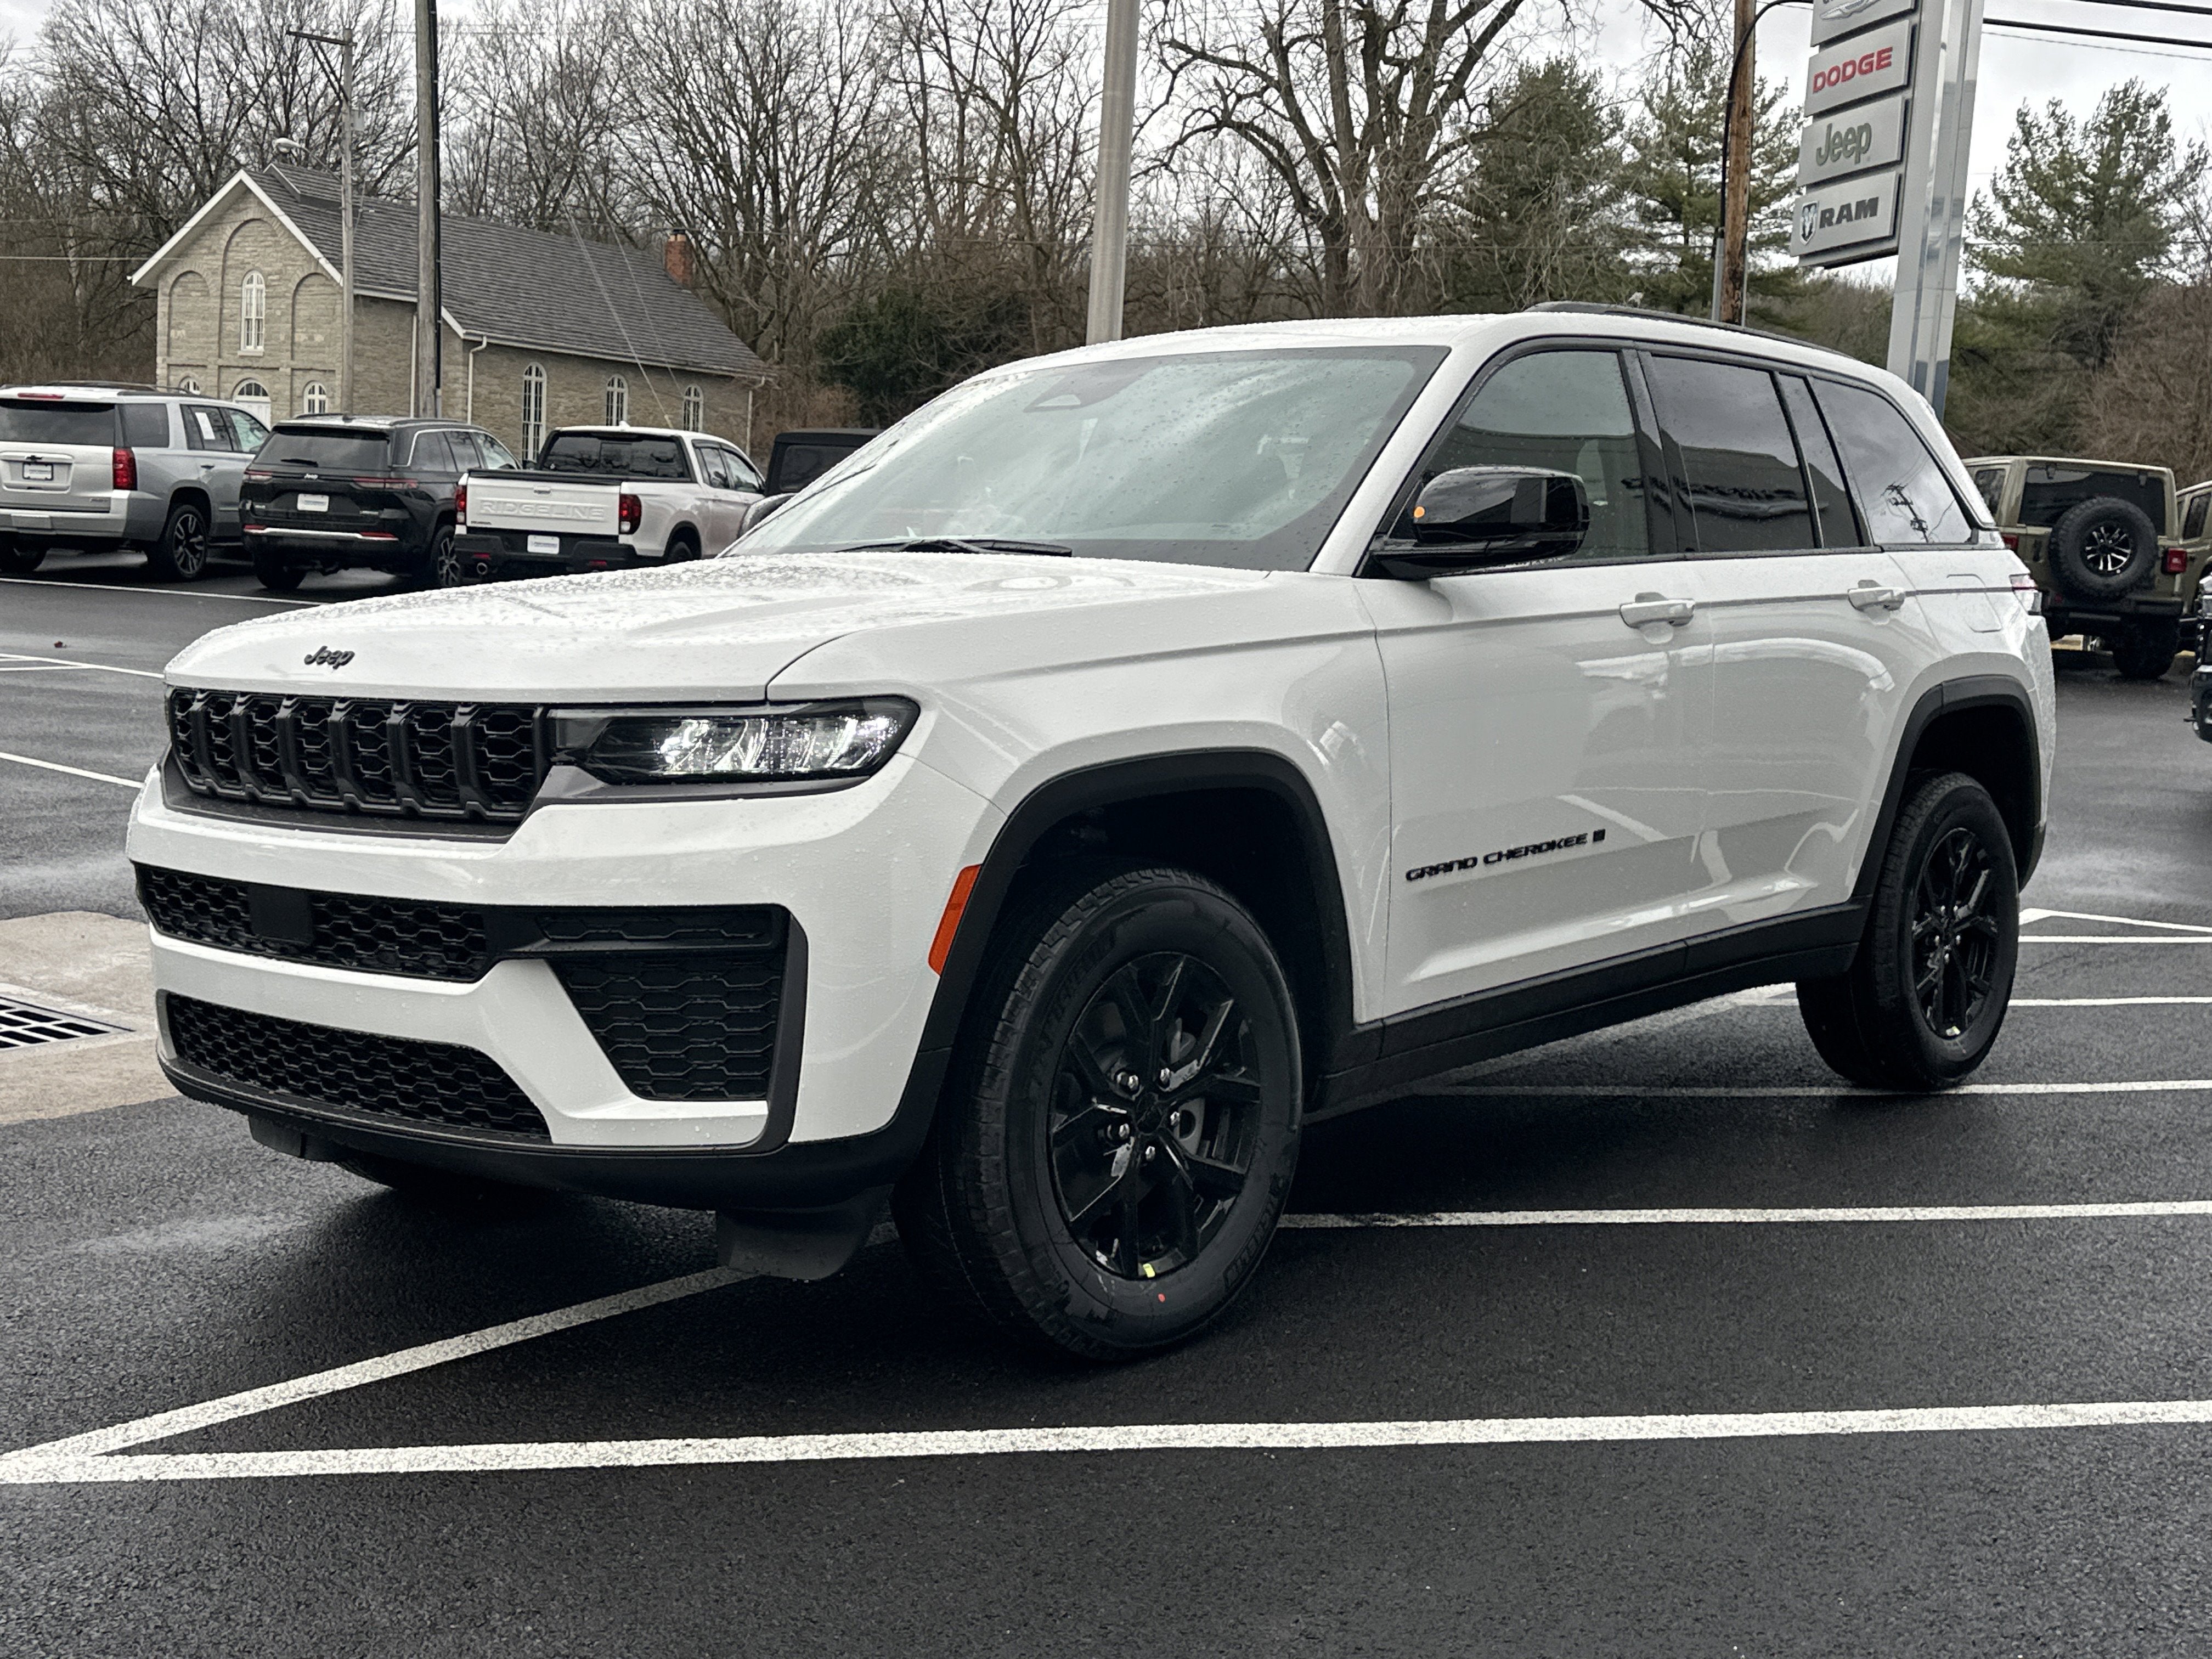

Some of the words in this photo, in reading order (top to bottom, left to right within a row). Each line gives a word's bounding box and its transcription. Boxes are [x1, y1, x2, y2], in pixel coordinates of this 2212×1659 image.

[1813, 47, 1892, 93] DODGE
[1816, 122, 1872, 166] Jeep
[1819, 197, 1879, 229] RAM
[480, 500, 605, 520] RIDGELINE
[304, 645, 355, 669] Jeep
[1405, 856, 1478, 882] GRAND
[1483, 833, 1588, 864] CHEROKEE
